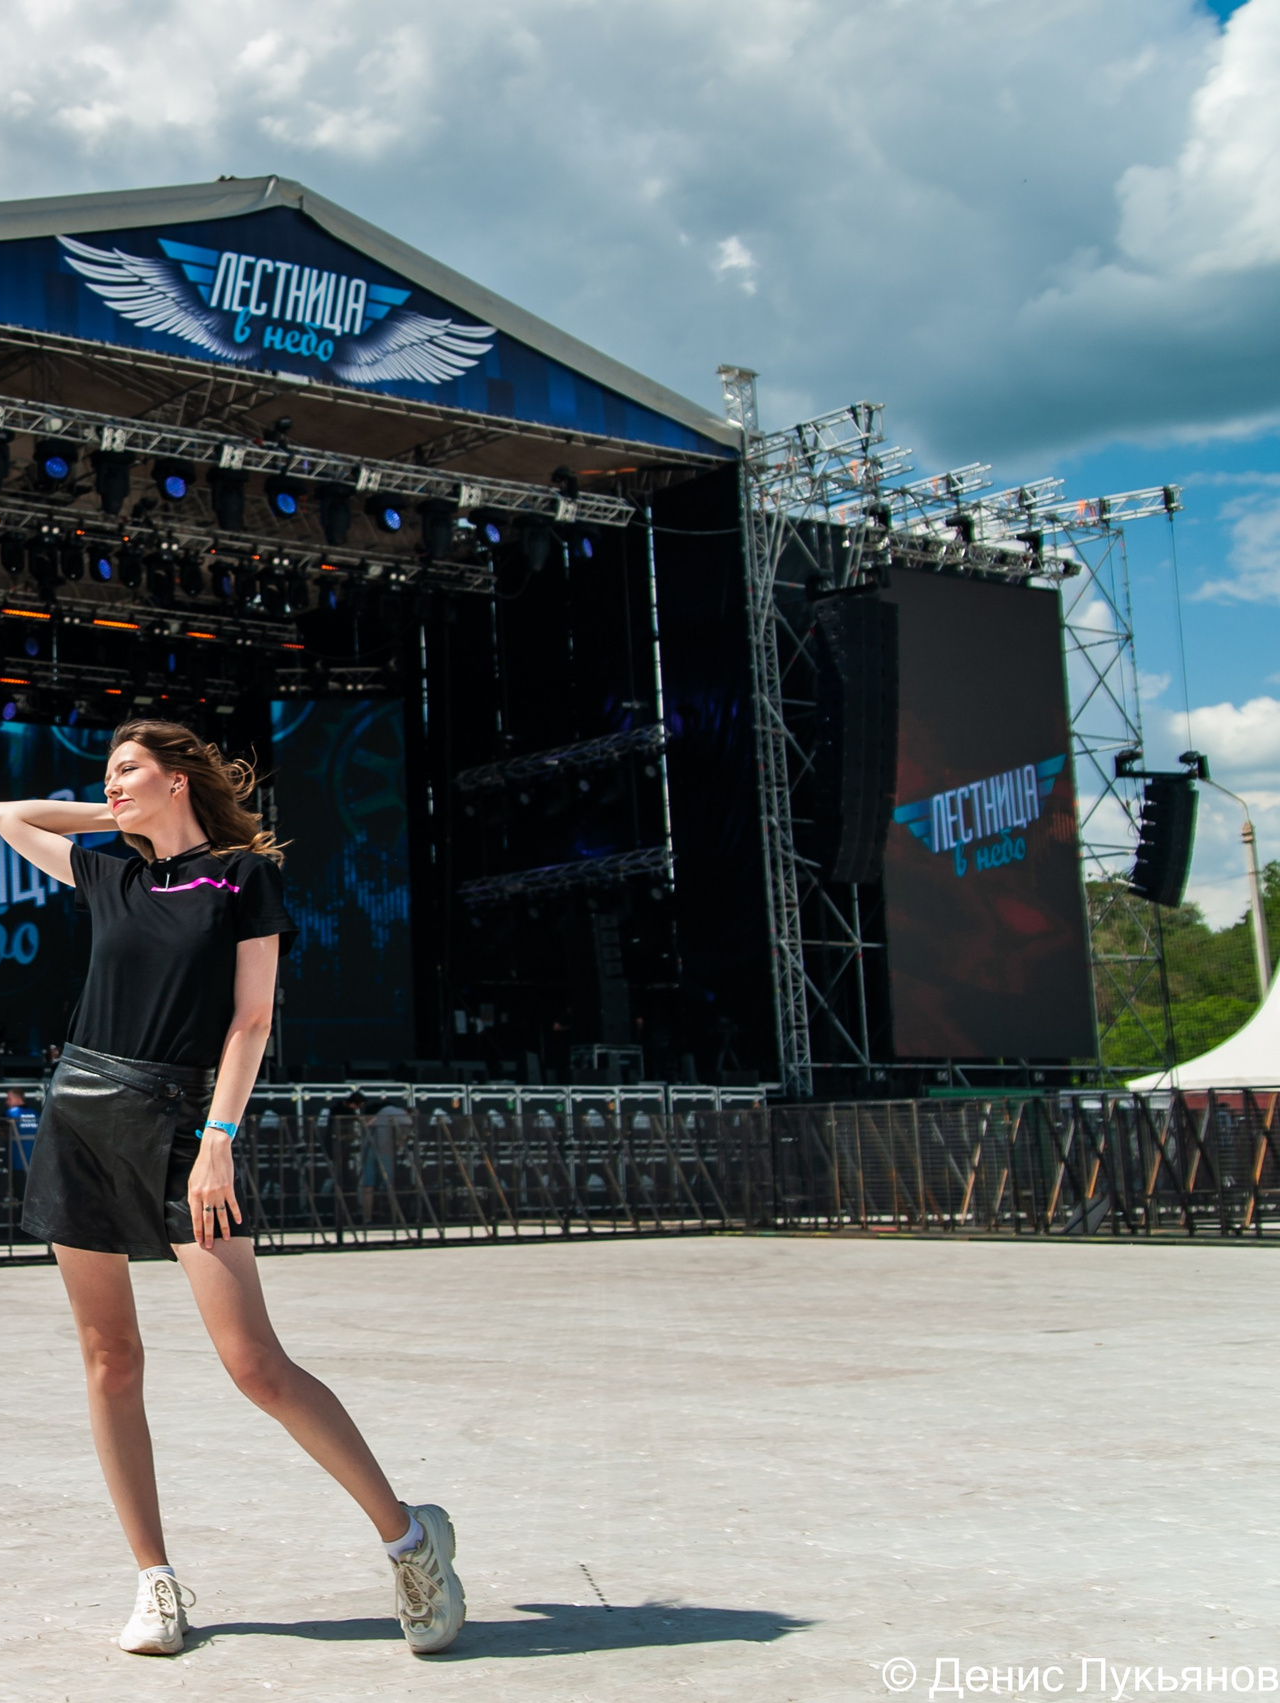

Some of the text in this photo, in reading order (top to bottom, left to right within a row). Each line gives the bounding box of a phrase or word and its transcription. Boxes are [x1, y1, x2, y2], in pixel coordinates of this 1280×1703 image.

[210, 252, 367, 336] ЛЕСТНИЦА
[233, 307, 335, 363] в небо
[932, 764, 1040, 854] ЛЕСТНИЦА
[954, 828, 1027, 878] в небо
